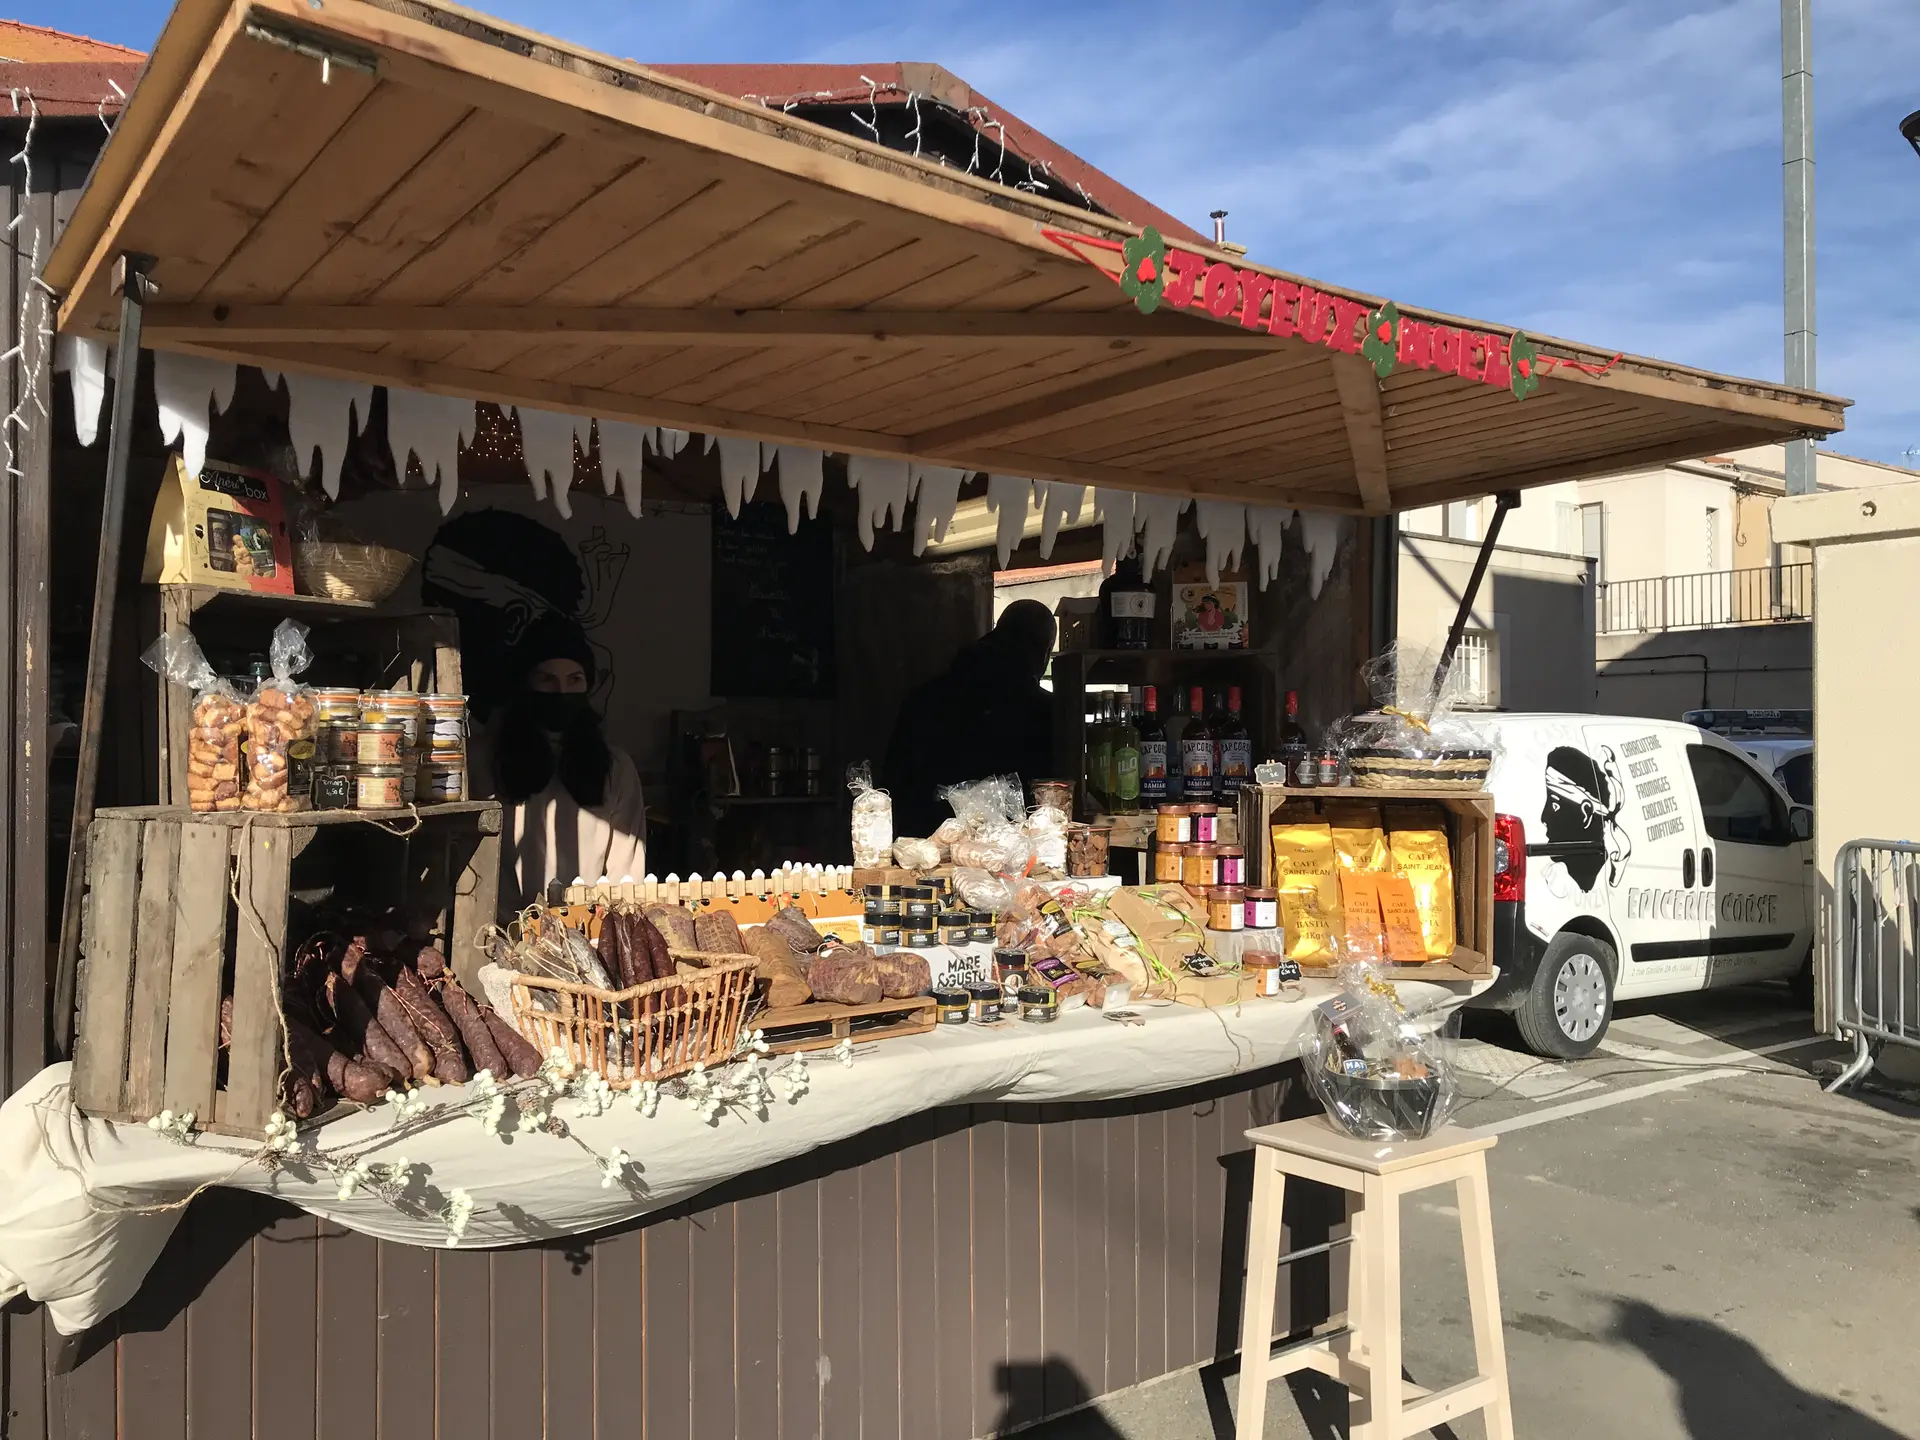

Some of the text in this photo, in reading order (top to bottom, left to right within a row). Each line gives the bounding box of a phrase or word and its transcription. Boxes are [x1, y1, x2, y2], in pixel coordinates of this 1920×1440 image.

[1165, 247, 1511, 389] JOYEUX NOEL
[244, 484, 268, 501] box
[1620, 734, 1662, 758] CHARCUTERIE
[1628, 757, 1659, 779] BISCUITS
[1636, 776, 1671, 800] FROMAGES
[1642, 796, 1678, 821] CHOCOLATS
[1646, 816, 1684, 842] CONFITURES
[1293, 859, 1318, 867] CAFÉ
[1721, 892, 1778, 924] CORSE
[1296, 920, 1330, 929] BASTIA
[947, 955, 981, 973] MARE
